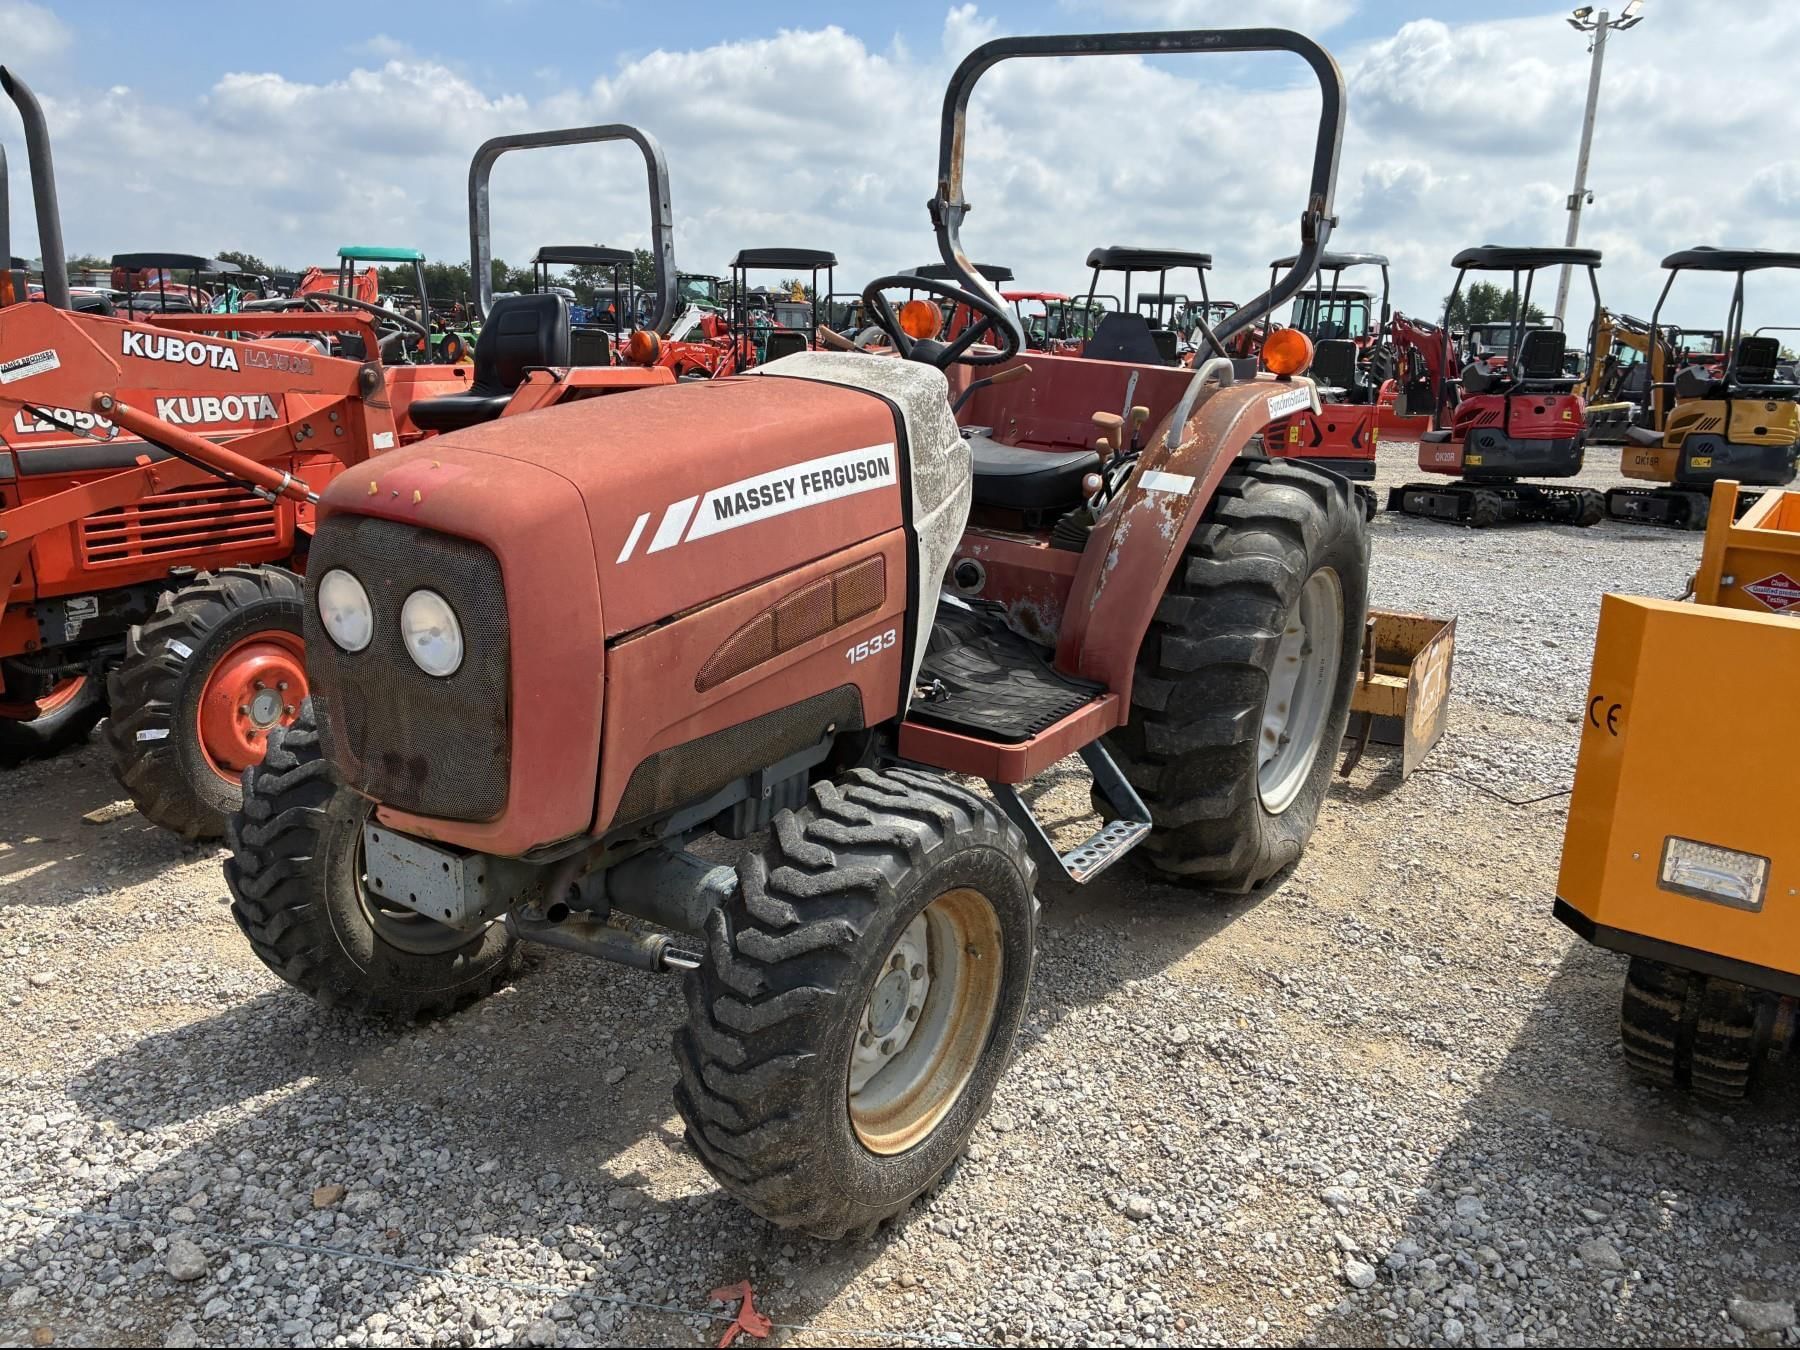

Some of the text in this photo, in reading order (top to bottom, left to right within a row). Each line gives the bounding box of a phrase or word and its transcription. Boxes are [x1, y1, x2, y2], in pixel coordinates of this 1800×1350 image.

[123, 330, 239, 371] KUBOTA
[156, 395, 278, 425] KUBOTA
[713, 457, 890, 520] MASSEY FERGUSON
[845, 628, 896, 665] 1533
